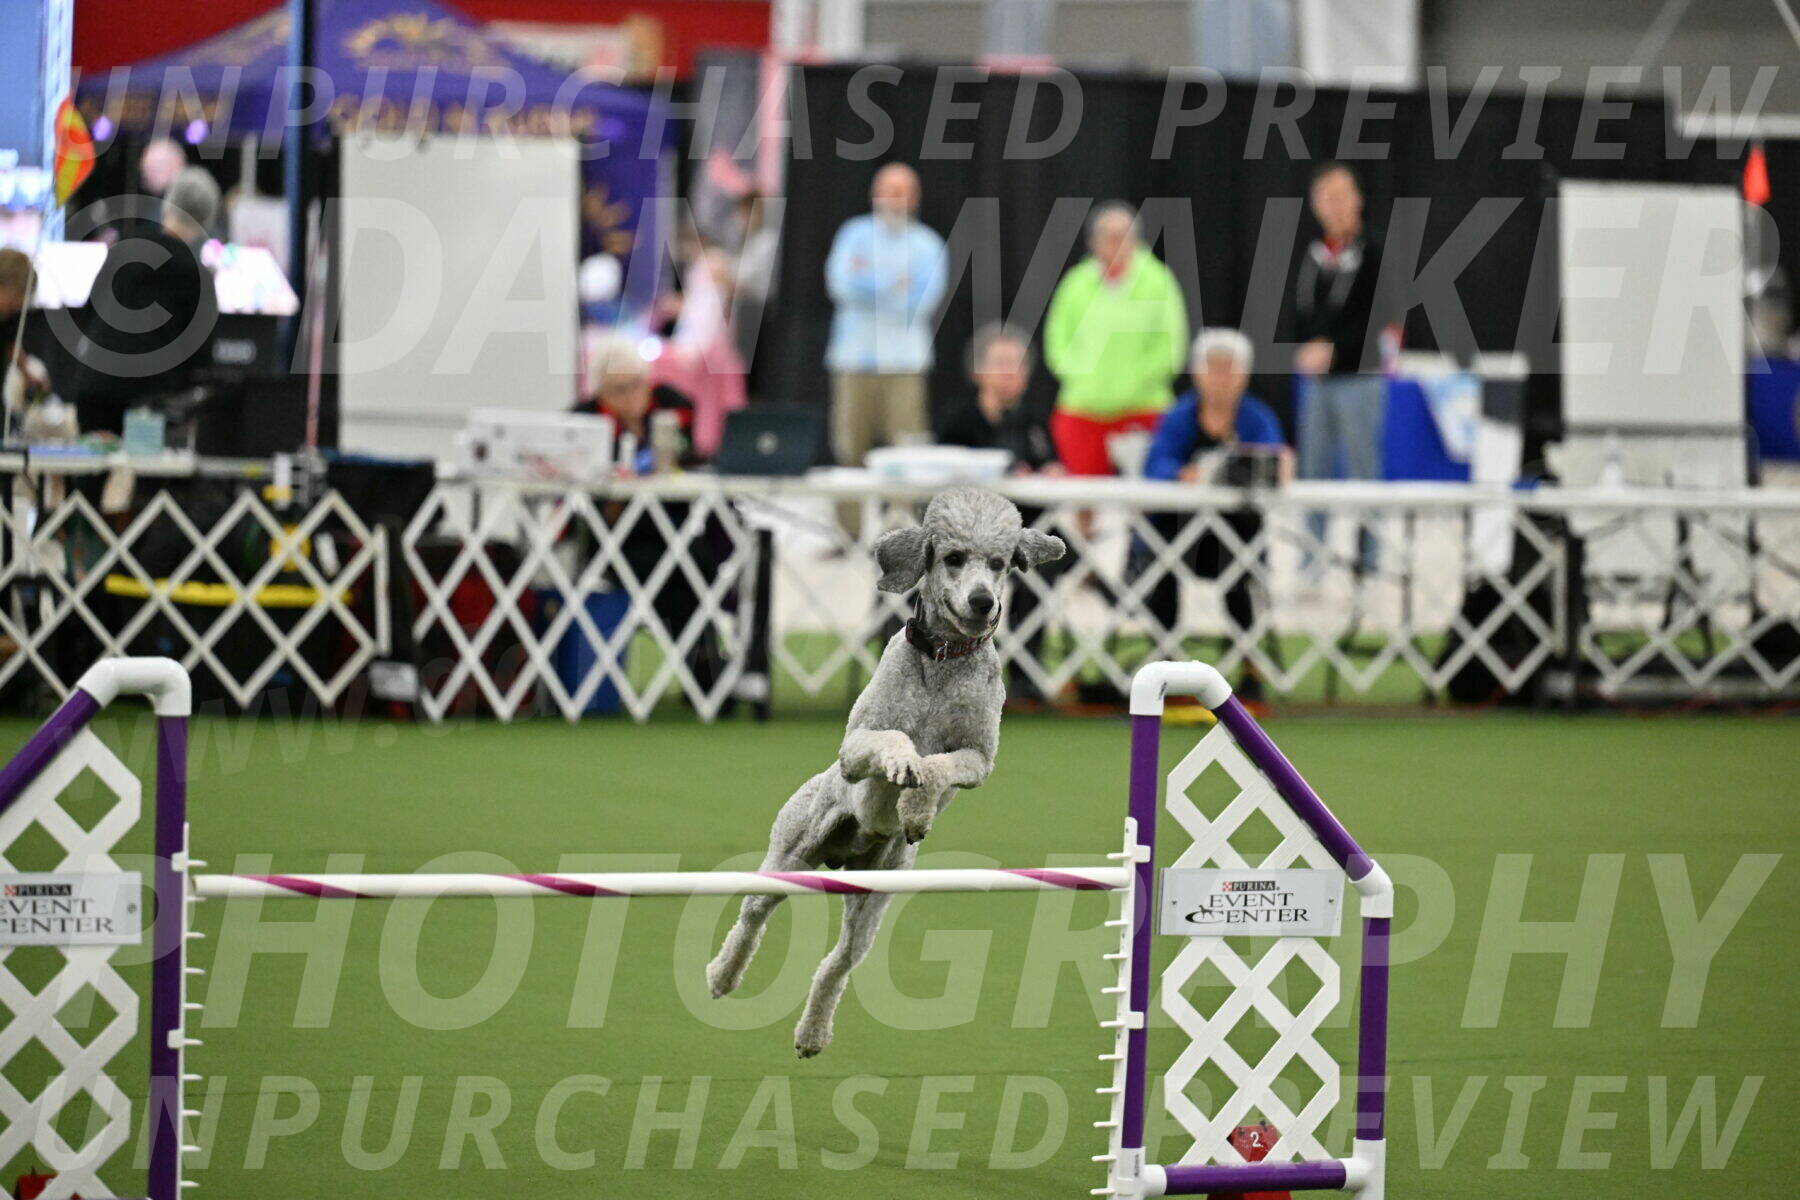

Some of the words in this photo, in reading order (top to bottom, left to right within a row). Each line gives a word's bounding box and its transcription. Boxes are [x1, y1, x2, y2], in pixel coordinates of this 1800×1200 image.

[1233, 881, 1276, 891] PURINA
[1209, 893, 1294, 908] EVENT
[1185, 908, 1310, 924] CENTER
[1250, 1131, 1263, 1147] 2
